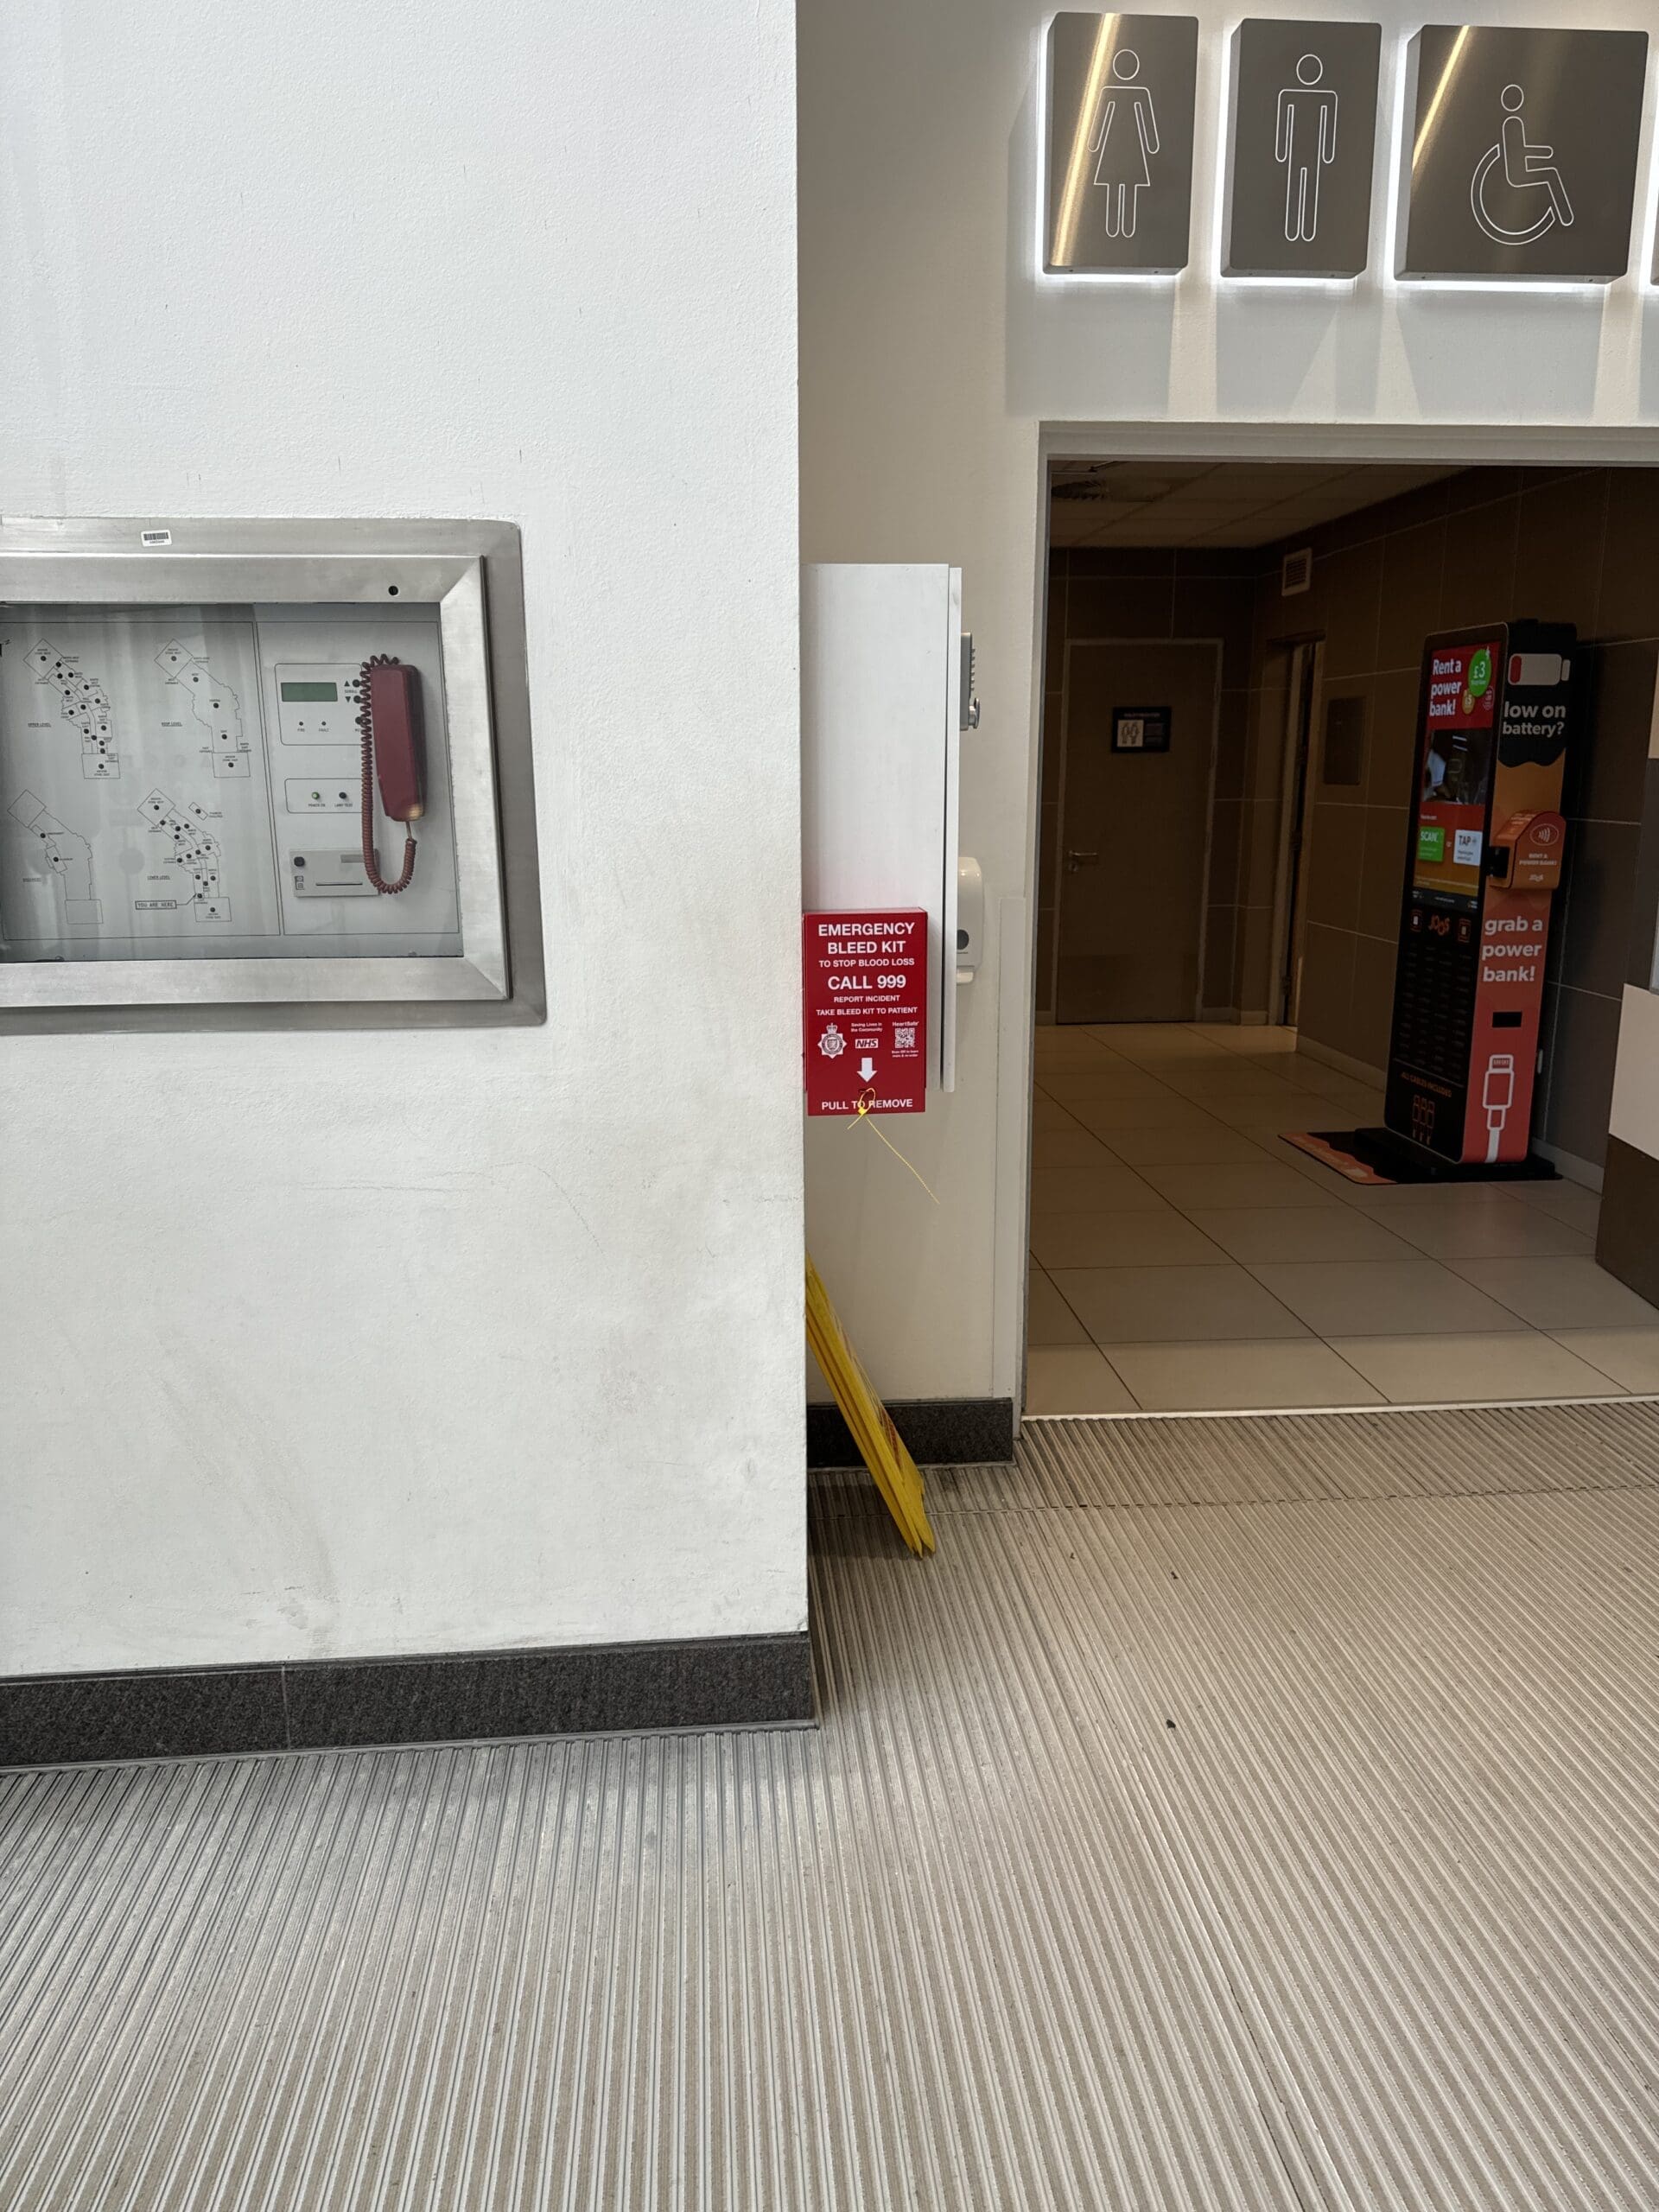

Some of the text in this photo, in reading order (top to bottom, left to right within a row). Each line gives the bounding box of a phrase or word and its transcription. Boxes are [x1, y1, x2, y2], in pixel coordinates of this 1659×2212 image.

[1432, 658, 1462, 676] Rent a
[1473, 661, 1485, 678] £3
[1430, 682, 1462, 700] power
[1429, 699, 1456, 716] bank!
[1503, 701, 1567, 718] low on
[1502, 721, 1565, 738] battery?
[1458, 835, 1471, 846] TAP
[818, 922, 915, 937] EMERGENCY
[1484, 916, 1543, 936] grab a
[828, 940, 906, 955] BLEED KIT
[1481, 944, 1542, 961] power
[833, 959, 856, 968] STOP
[858, 958, 890, 967] BLOOD
[892, 957, 915, 966] LOSS
[1483, 965, 1535, 982] bank!
[828, 975, 906, 990] CALL 999
[822, 1098, 913, 1110] PULL TO REMOVE
